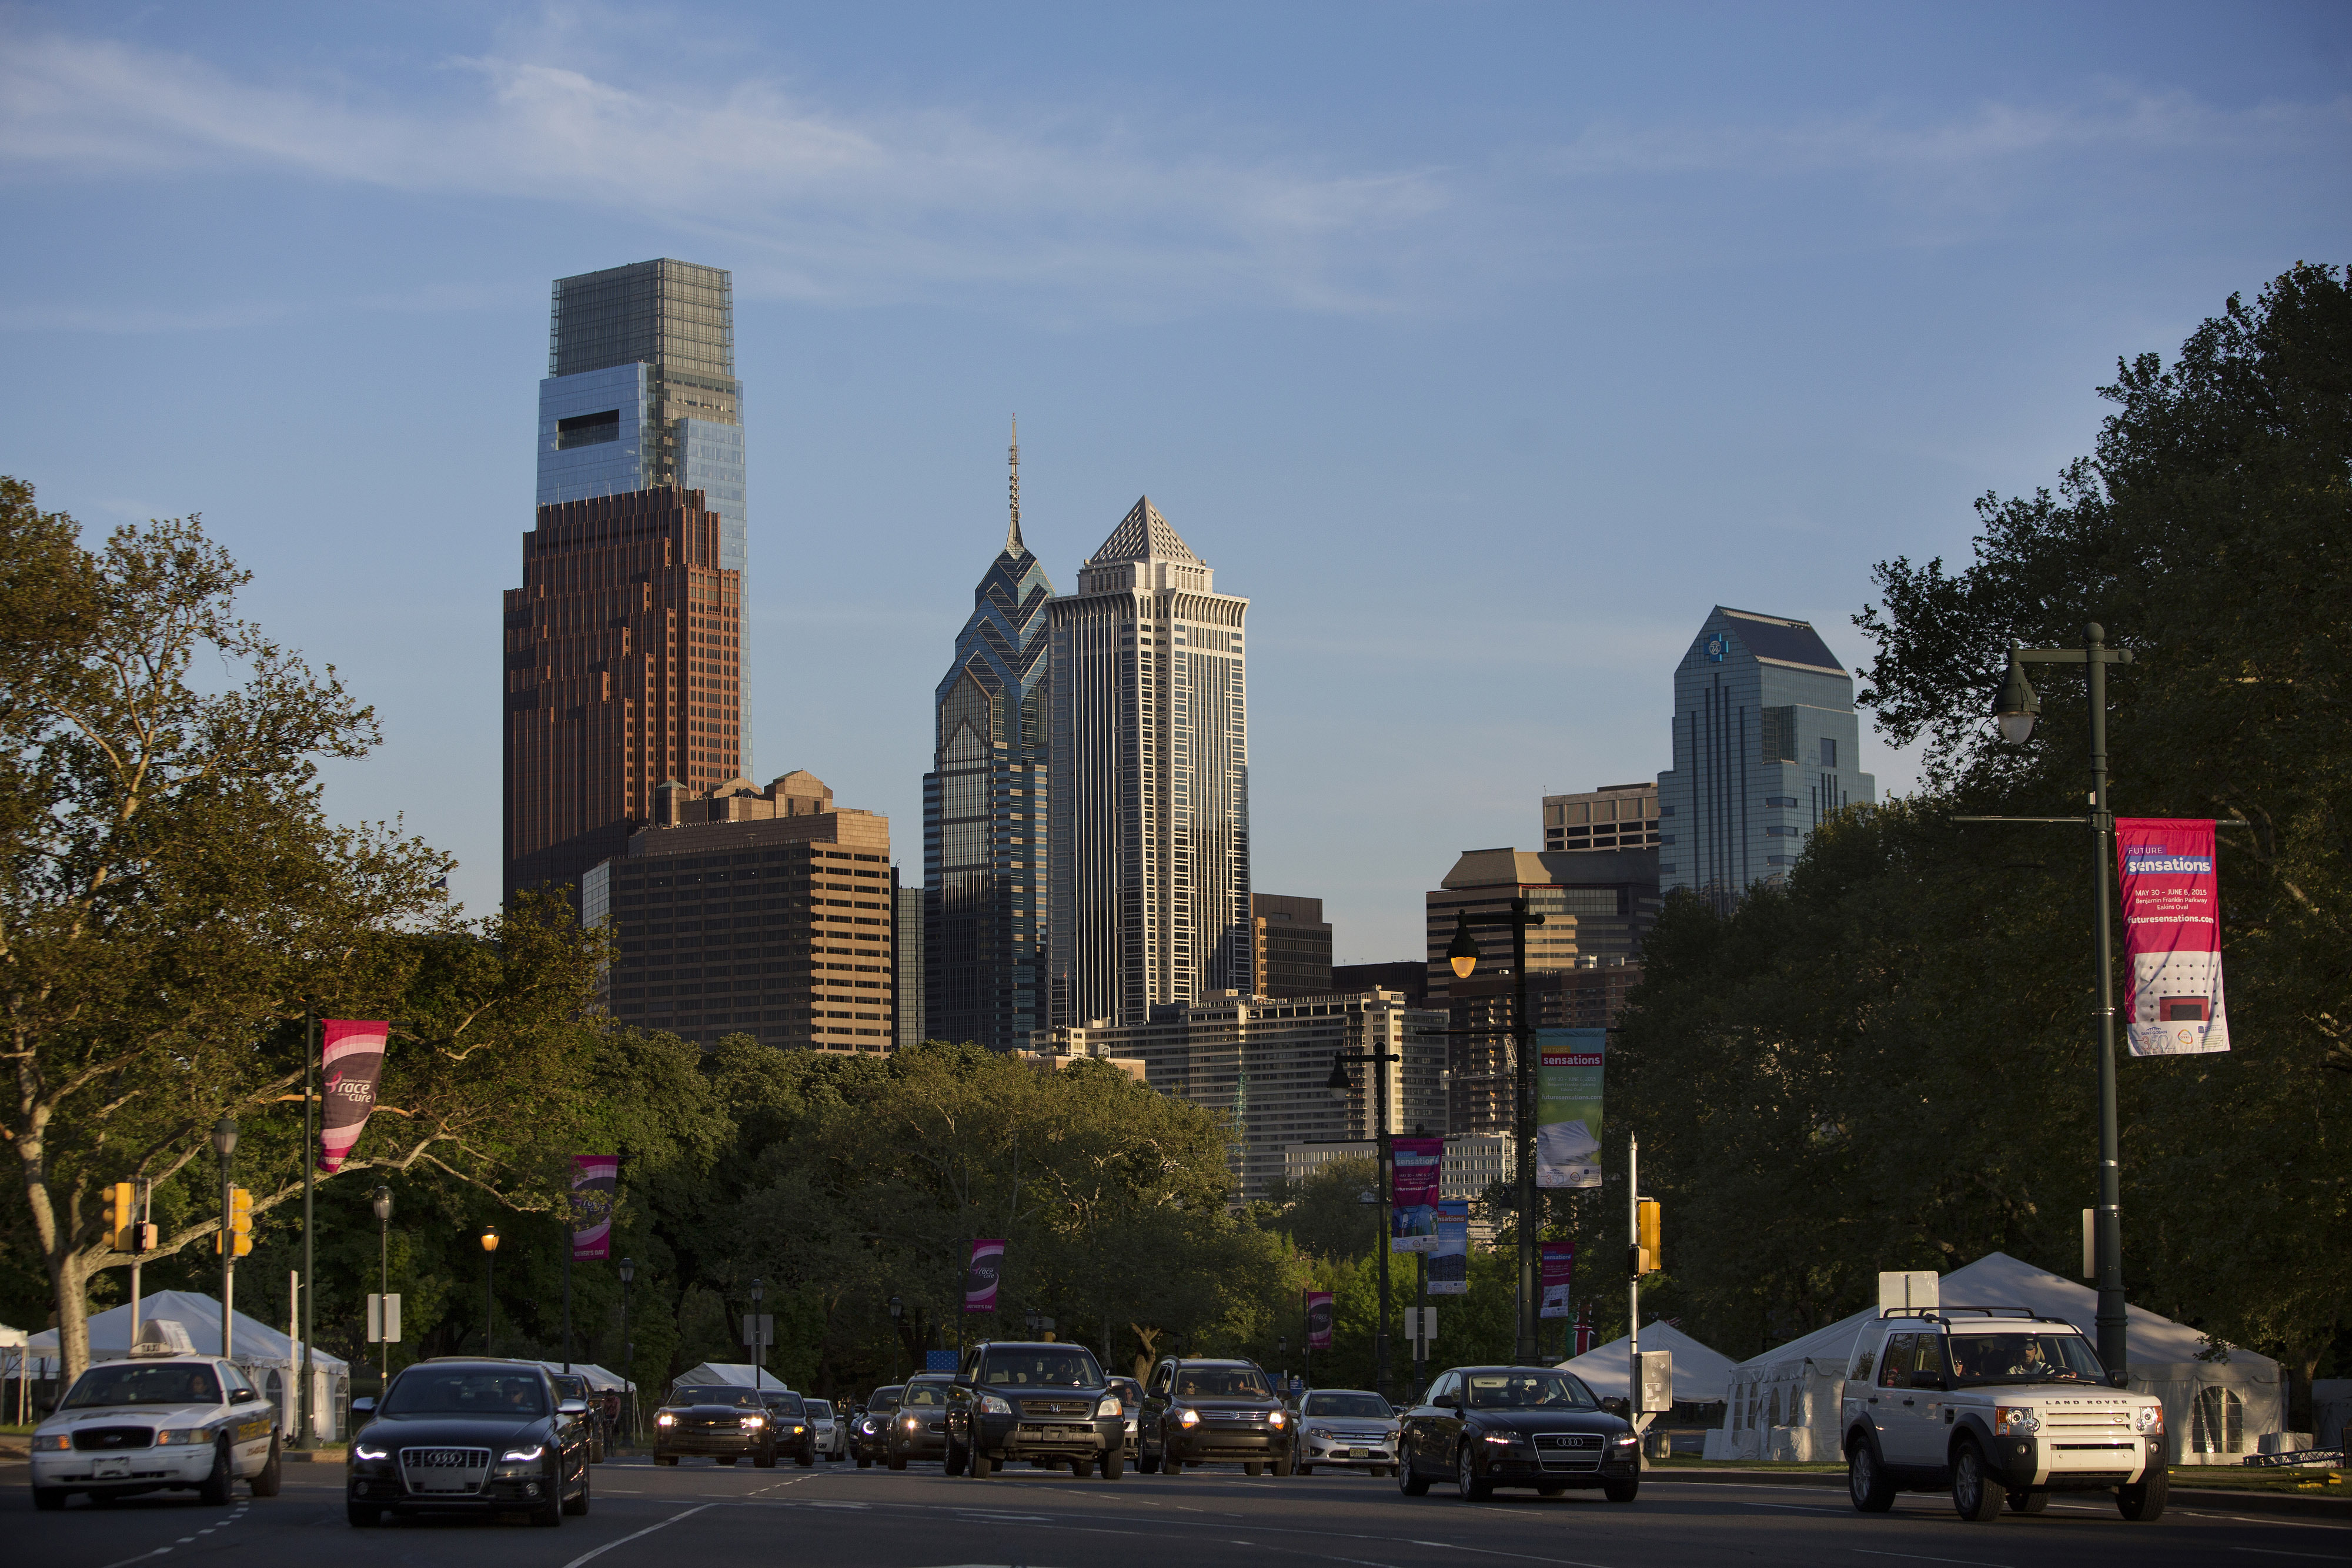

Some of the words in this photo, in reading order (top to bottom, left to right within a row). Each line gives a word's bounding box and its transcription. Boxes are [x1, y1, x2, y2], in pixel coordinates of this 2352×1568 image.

[2129, 857, 2211, 872] sensations
[2127, 914, 2214, 924] futuresensations.com
[1544, 1055, 1600, 1064] sensations
[338, 1082, 370, 1094] race
[349, 1094, 372, 1102] cure
[1396, 1157, 1438, 1165] sensations
